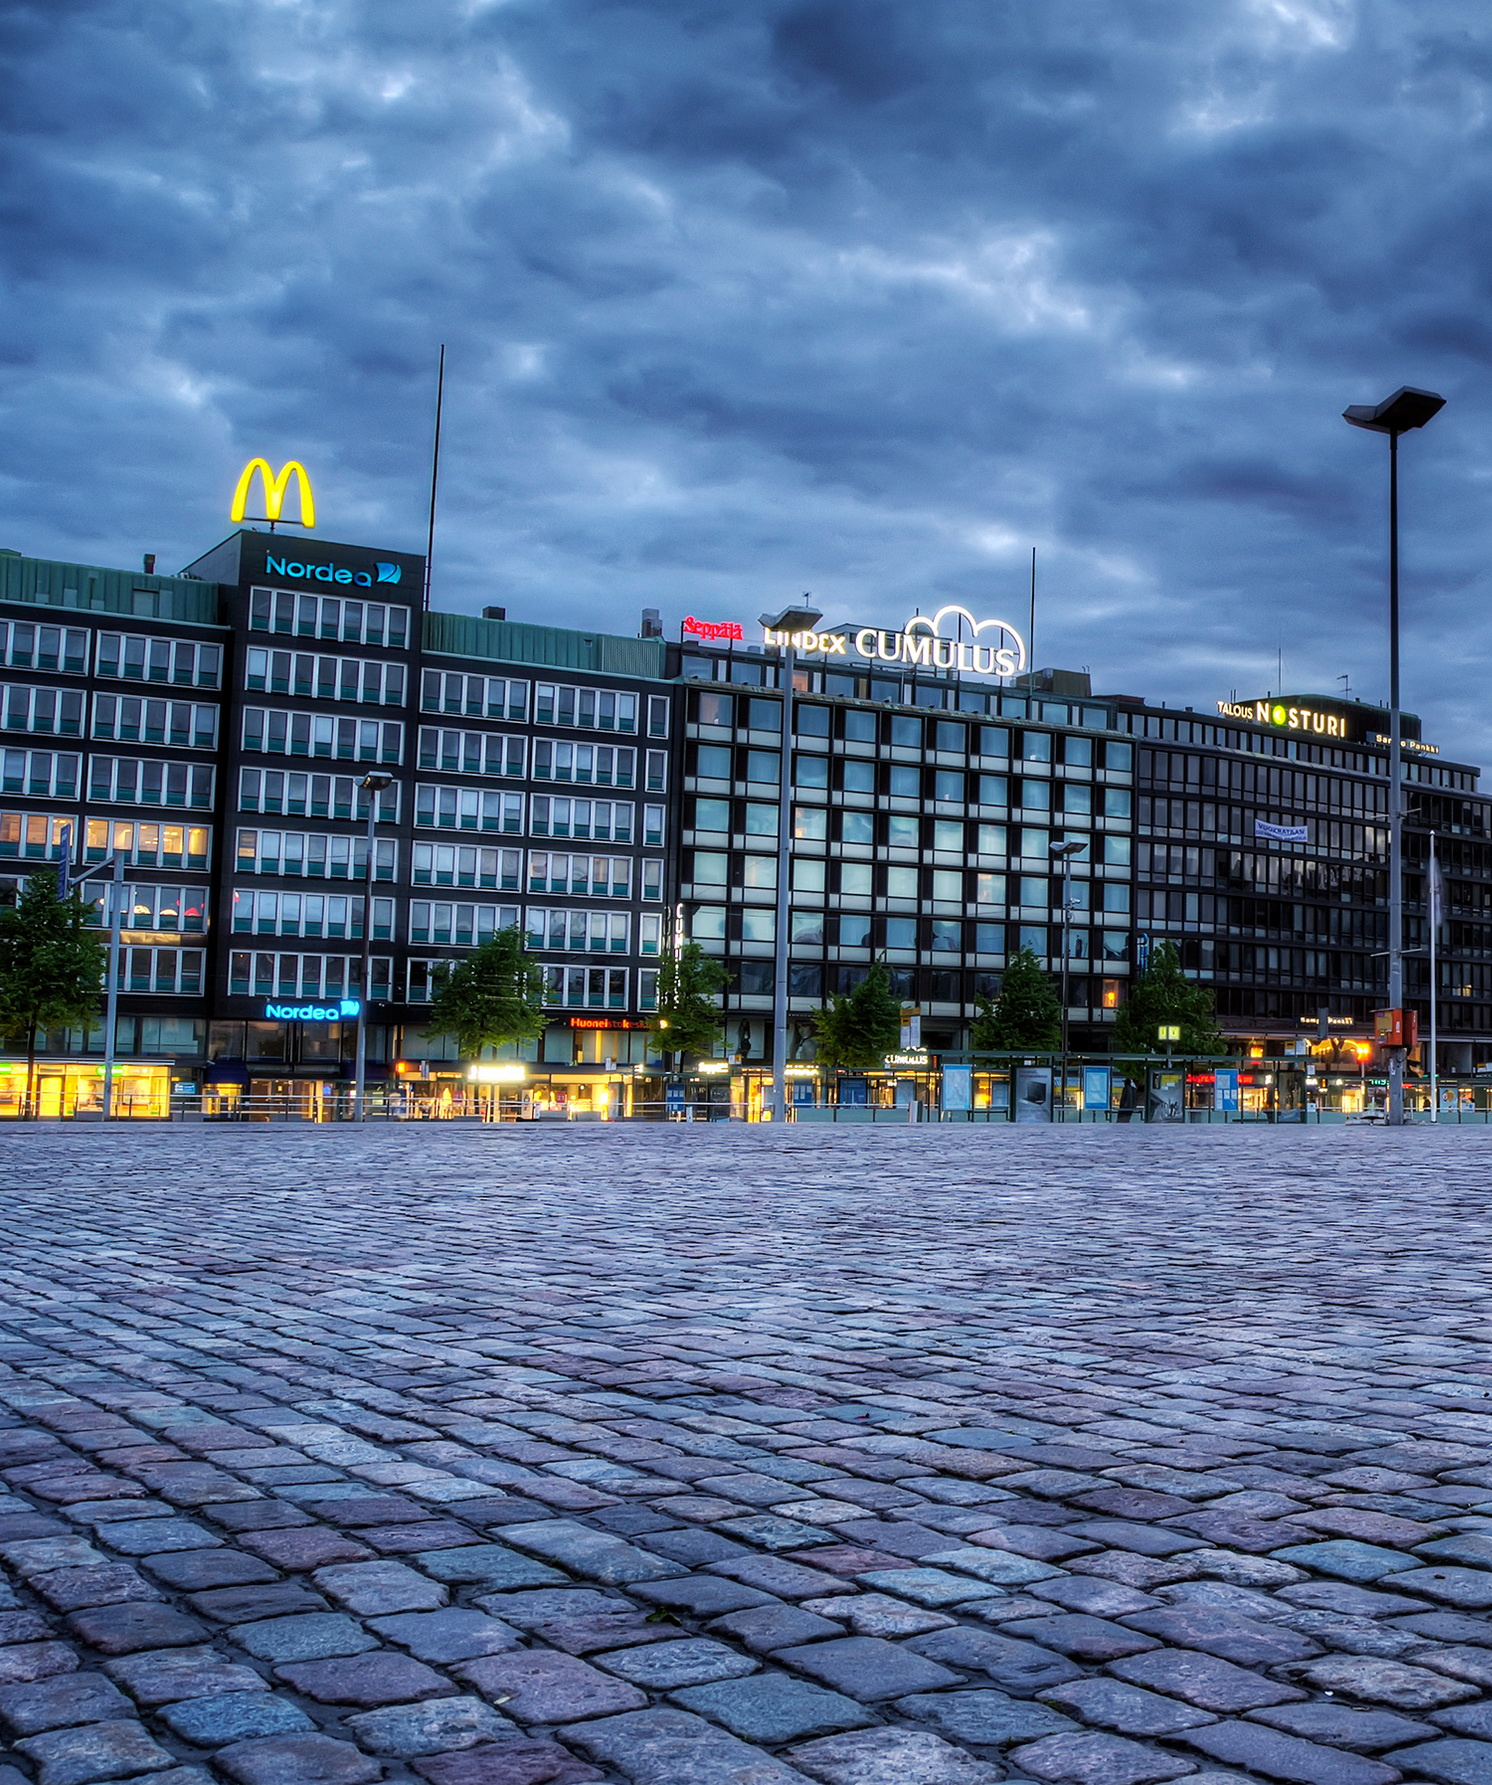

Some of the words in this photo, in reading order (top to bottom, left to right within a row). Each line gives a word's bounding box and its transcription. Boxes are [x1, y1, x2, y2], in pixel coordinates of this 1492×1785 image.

[266, 555, 372, 587] Nordea
[684, 615, 743, 640] Seppälä
[855, 628, 1016, 677] CUMULUS
[1217, 701, 1253, 719] TALOUS
[1409, 741, 1439, 754] Pankki
[266, 1004, 339, 1020] Nordea
[885, 1055, 928, 1064] CUMULUS
